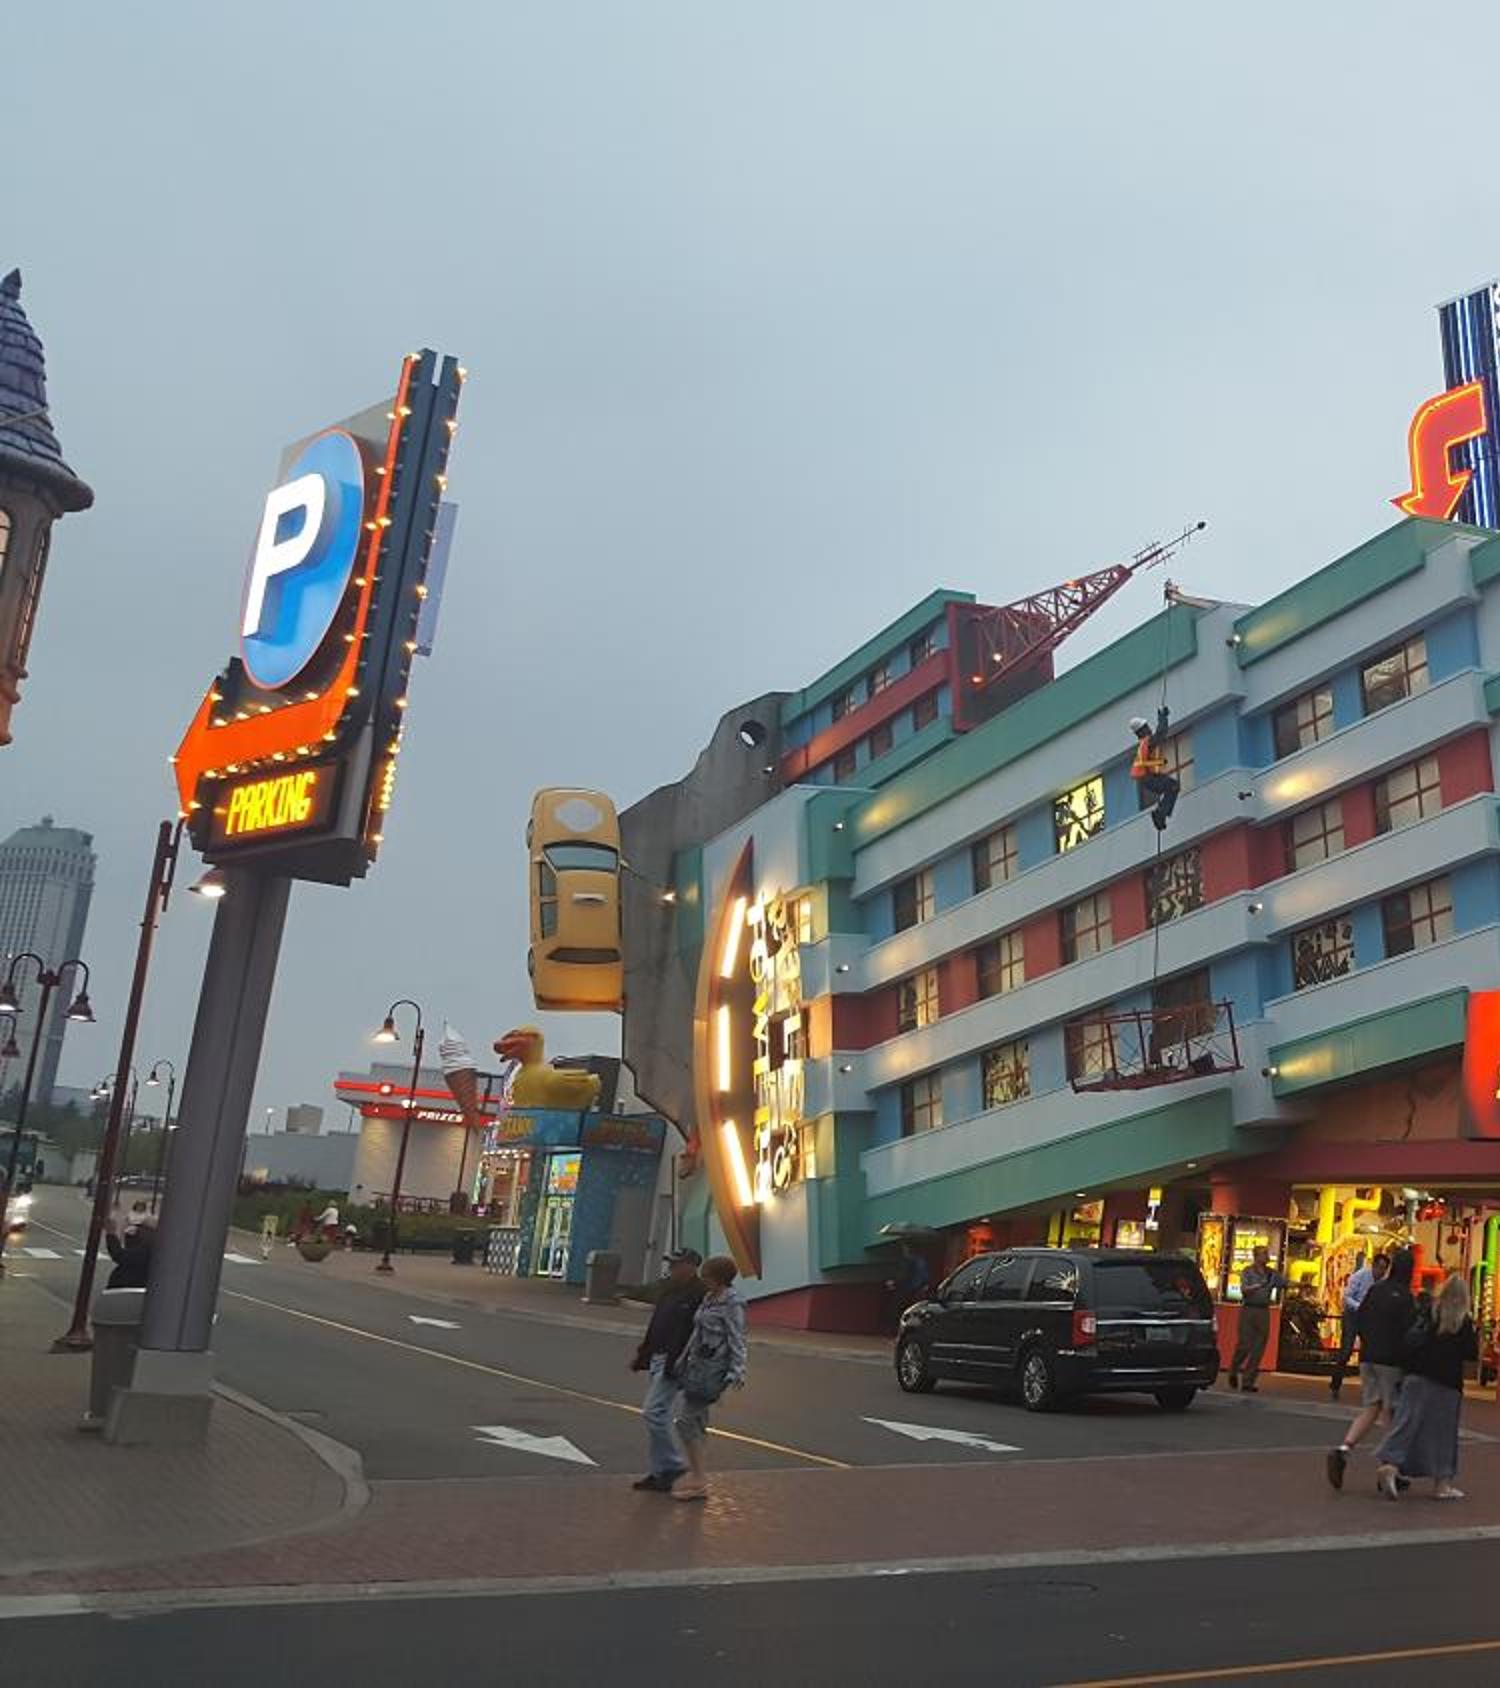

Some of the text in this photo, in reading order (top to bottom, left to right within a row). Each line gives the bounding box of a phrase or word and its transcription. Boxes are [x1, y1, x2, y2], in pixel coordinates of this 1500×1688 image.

[242, 472, 326, 639] P
[225, 771, 316, 835] PARKING
[417, 1111, 464, 1123] PRIZES
